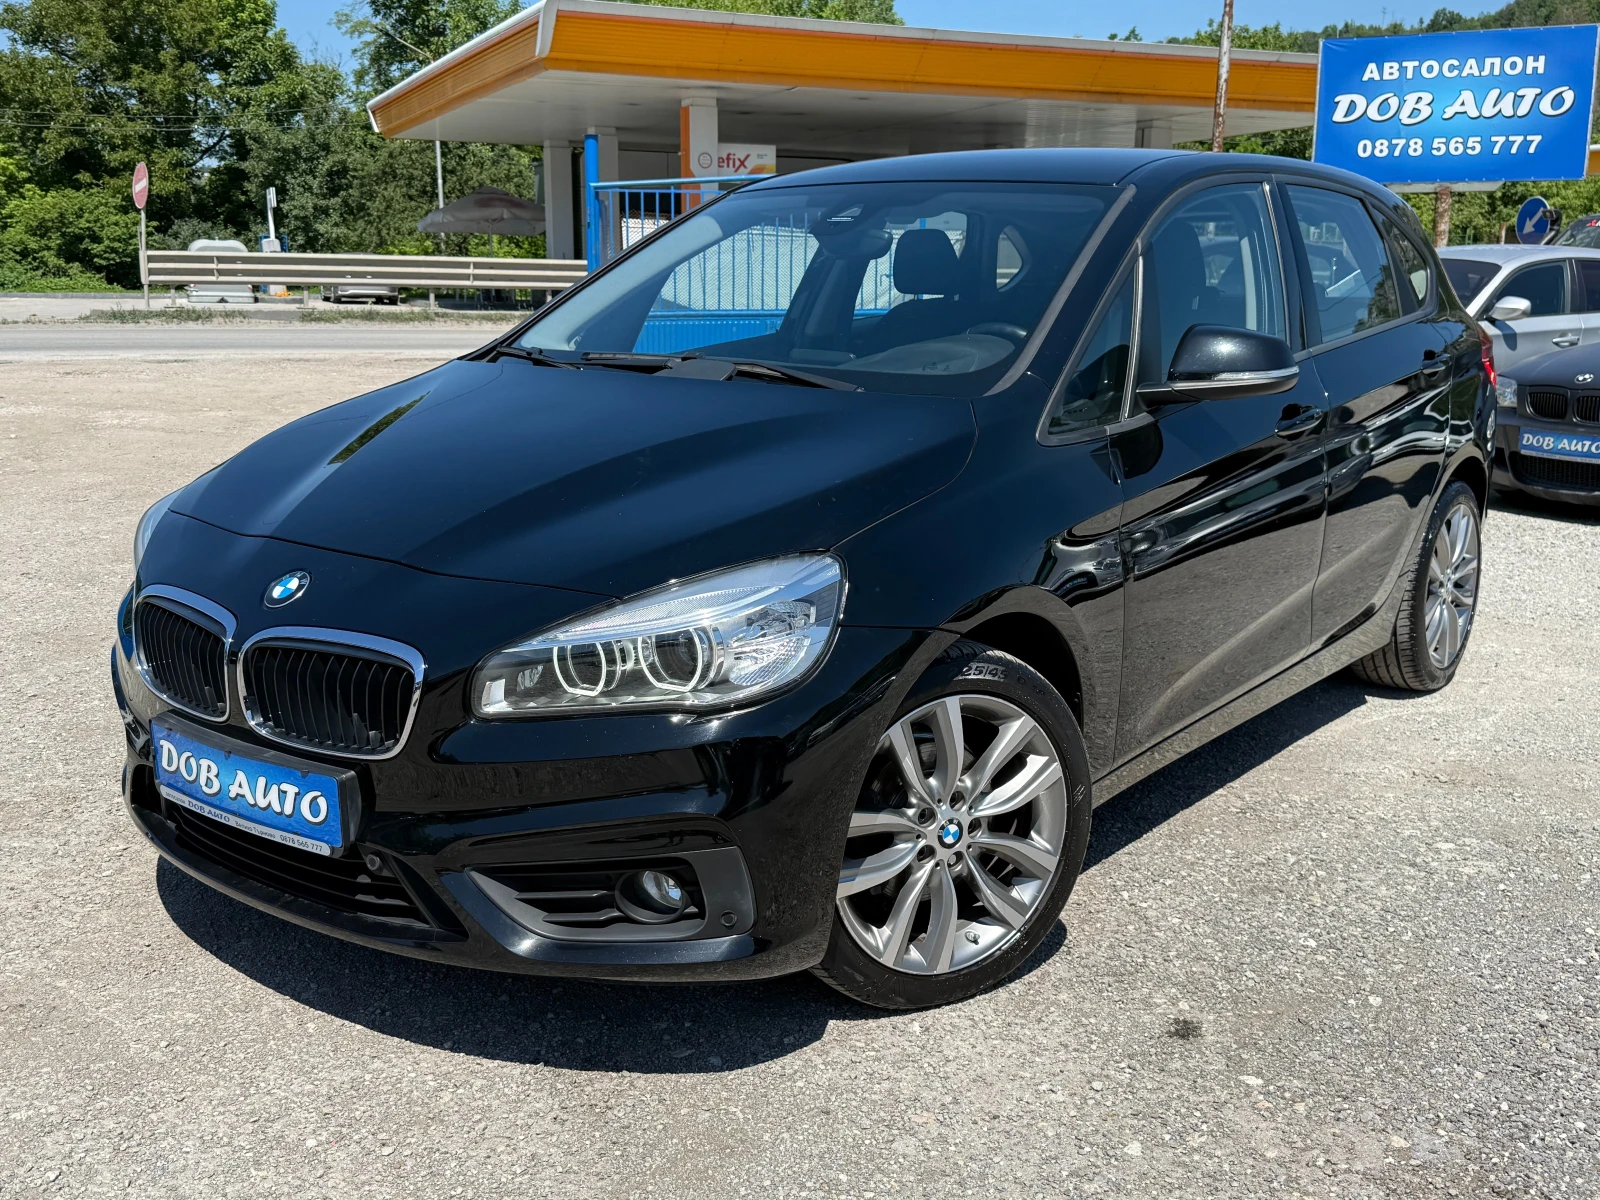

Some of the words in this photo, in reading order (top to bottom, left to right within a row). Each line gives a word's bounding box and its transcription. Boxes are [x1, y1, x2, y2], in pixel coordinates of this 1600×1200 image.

[1361, 55, 1547, 82] АВТОСАЛОН
[1331, 91, 1435, 125] DOB
[1442, 85, 1576, 120] AUTO
[1356, 138, 1423, 158] 0878
[1430, 136, 1482, 156] 565
[1490, 134, 1543, 154] 777
[1522, 433, 1555, 450] DOB
[159, 739, 222, 796] DOB
[228, 769, 329, 825] AUTO
[188, 800, 206, 814] DOB
[207, 809, 231, 823] AUTO
[280, 834, 296, 845] 0878
[296, 839, 309, 849] 565
[310, 842, 323, 852] 777
